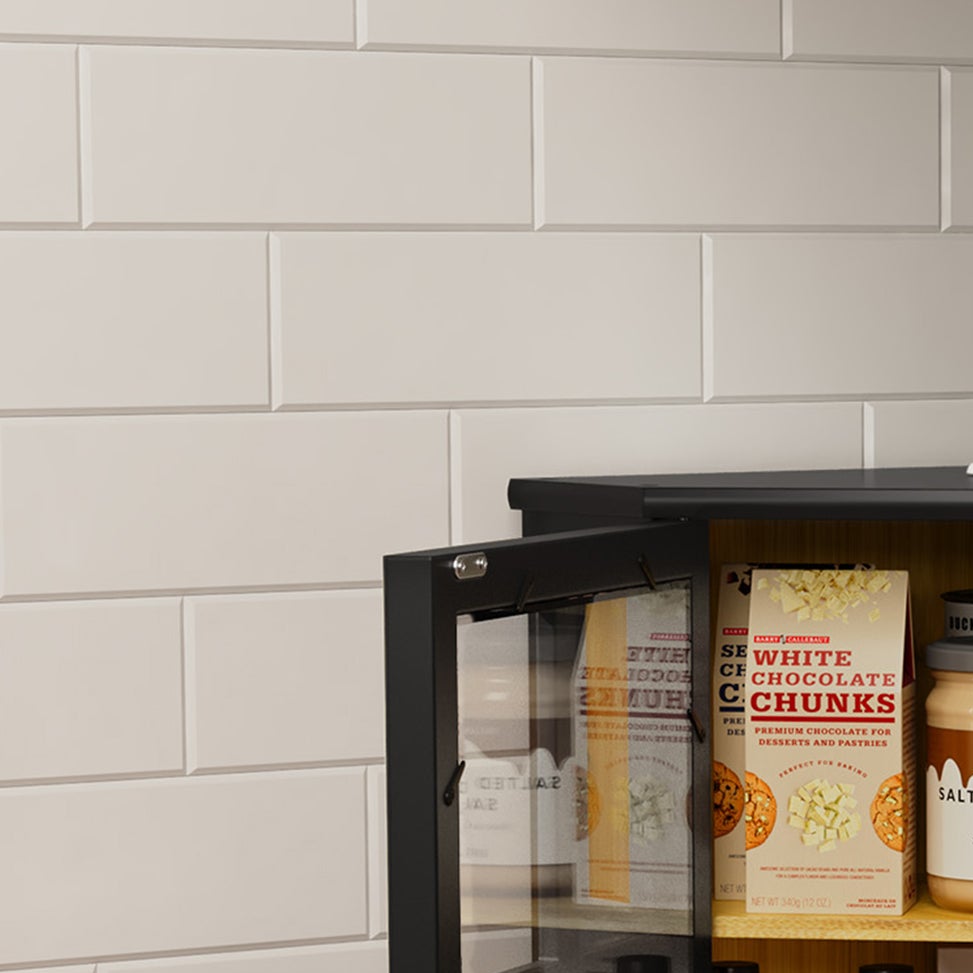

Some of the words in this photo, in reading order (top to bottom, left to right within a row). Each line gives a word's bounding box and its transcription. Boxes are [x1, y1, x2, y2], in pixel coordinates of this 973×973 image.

[753, 649, 852, 667] WHITE
[751, 672, 896, 687] CHOCOLATE
[718, 682, 745, 704] C
[750, 691, 896, 714] CHUNKS
[723, 717, 746, 725] PRE
[754, 727, 804, 735] PREMIUM
[806, 727, 869, 736] CHOCOLATE
[871, 728, 892, 736] FOR
[758, 738, 811, 747] DESSERTS
[813, 738, 836, 747] AND
[838, 739, 888, 748] PASTRIES
[779, 760, 814, 778] PERFECT
[836, 761, 868, 778] BAKING
[751, 897, 766, 906] NET
[767, 897, 780, 906] WT
